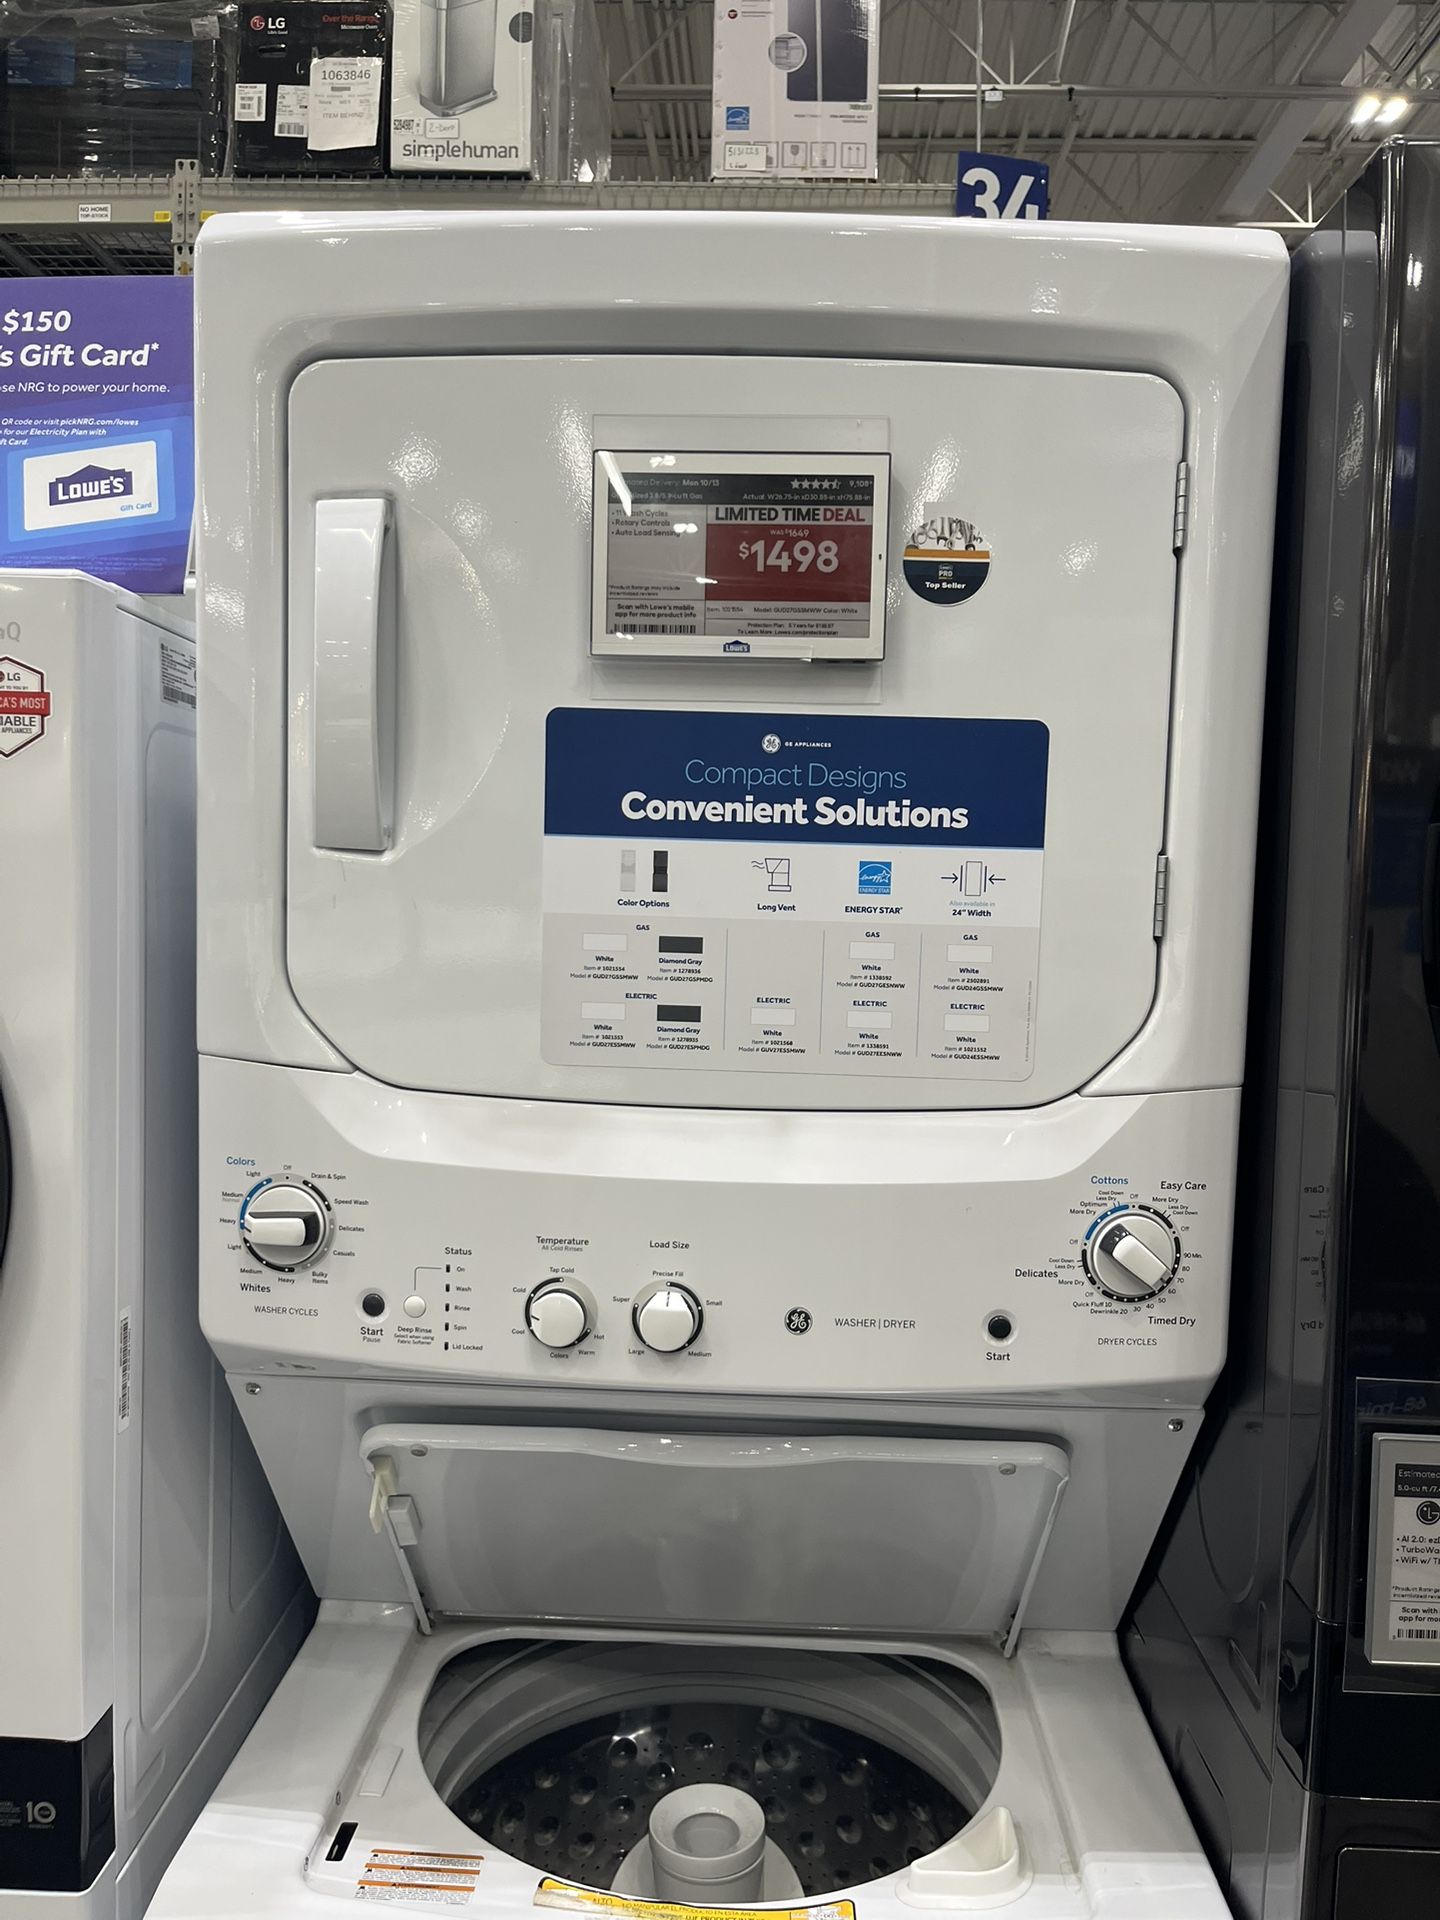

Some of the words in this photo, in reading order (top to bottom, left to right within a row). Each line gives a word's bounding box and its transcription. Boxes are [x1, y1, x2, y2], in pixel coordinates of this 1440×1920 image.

[268, 17, 286, 29] LG
[321, 69, 371, 81] 1063846
[402, 139, 519, 161] simplehuman
[961, 167, 1039, 219] 34
[2, 309, 72, 335] $150
[20, 343, 75, 367] Gift
[18, 382, 45, 393] NRG
[48, 382, 60, 393] to
[62, 383, 100, 395] power
[101, 384, 130, 395] your
[132, 382, 170, 393] home.
[1, 418, 14, 426] QR
[14, 418, 33, 426] code
[43, 418, 59, 426] visit
[60, 418, 139, 426] pickNRG.com/lowes
[3, 428, 15, 436] for
[29, 428, 70, 437] Electricity
[57, 476, 125, 501] LOWE'S
[120, 504, 134, 512] Gift
[135, 502, 152, 510] Card
[645, 510, 668, 519] Cycles
[715, 507, 778, 521] LIMITED
[782, 507, 820, 522] TIME
[823, 507, 865, 522] DEAL
[615, 520, 638, 528] Rotary
[785, 529, 810, 538] $1649
[738, 540, 839, 573] $1498
[925, 581, 940, 590] Top
[941, 581, 966, 589] Seller
[7, 672, 21, 681] LG
[20, 697, 46, 709] MOST
[0, 716, 37, 727] IABLE
[685, 759, 802, 790] Compact
[808, 763, 907, 795] Designs
[621, 790, 809, 825] Convenient
[814, 796, 969, 829] Solutions
[617, 898, 638, 907] Color
[639, 899, 670, 908] Options
[757, 903, 777, 913] Long
[844, 905, 878, 914] ENERGY
[967, 909, 992, 917] Width
[658, 957, 687, 965] Diamond
[687, 959, 703, 967] Gray
[625, 992, 658, 1000] ELECTRIC
[226, 1156, 256, 1166] Colors
[1090, 1175, 1129, 1185] Cottons
[1160, 1181, 1183, 1191] Easy
[1184, 1181, 1207, 1190] Care
[536, 1236, 589, 1246] Temperature
[649, 1240, 670, 1249] Load
[672, 1241, 690, 1249] Size
[444, 1246, 473, 1256] Status
[1015, 1269, 1059, 1278] Delicates
[240, 1283, 271, 1293] Whites
[254, 1305, 288, 1314] WASHER
[288, 1308, 319, 1317] CYCLES
[834, 1317, 877, 1328] WASHER
[883, 1319, 916, 1329] DRYER
[1148, 1316, 1177, 1325] Timed
[1179, 1316, 1196, 1327] Dry
[360, 1327, 384, 1336] Start
[397, 1326, 414, 1334] Deep
[1097, 1337, 1125, 1346] DRYER
[1126, 1338, 1157, 1346] CYCLES
[985, 1352, 1011, 1361] Start
[1401, 1535, 1409, 1543] AI
[1400, 1556, 1419, 1564] WiFi
[1398, 1615, 1414, 1623] app
[25, 1801, 57, 1824] 10
